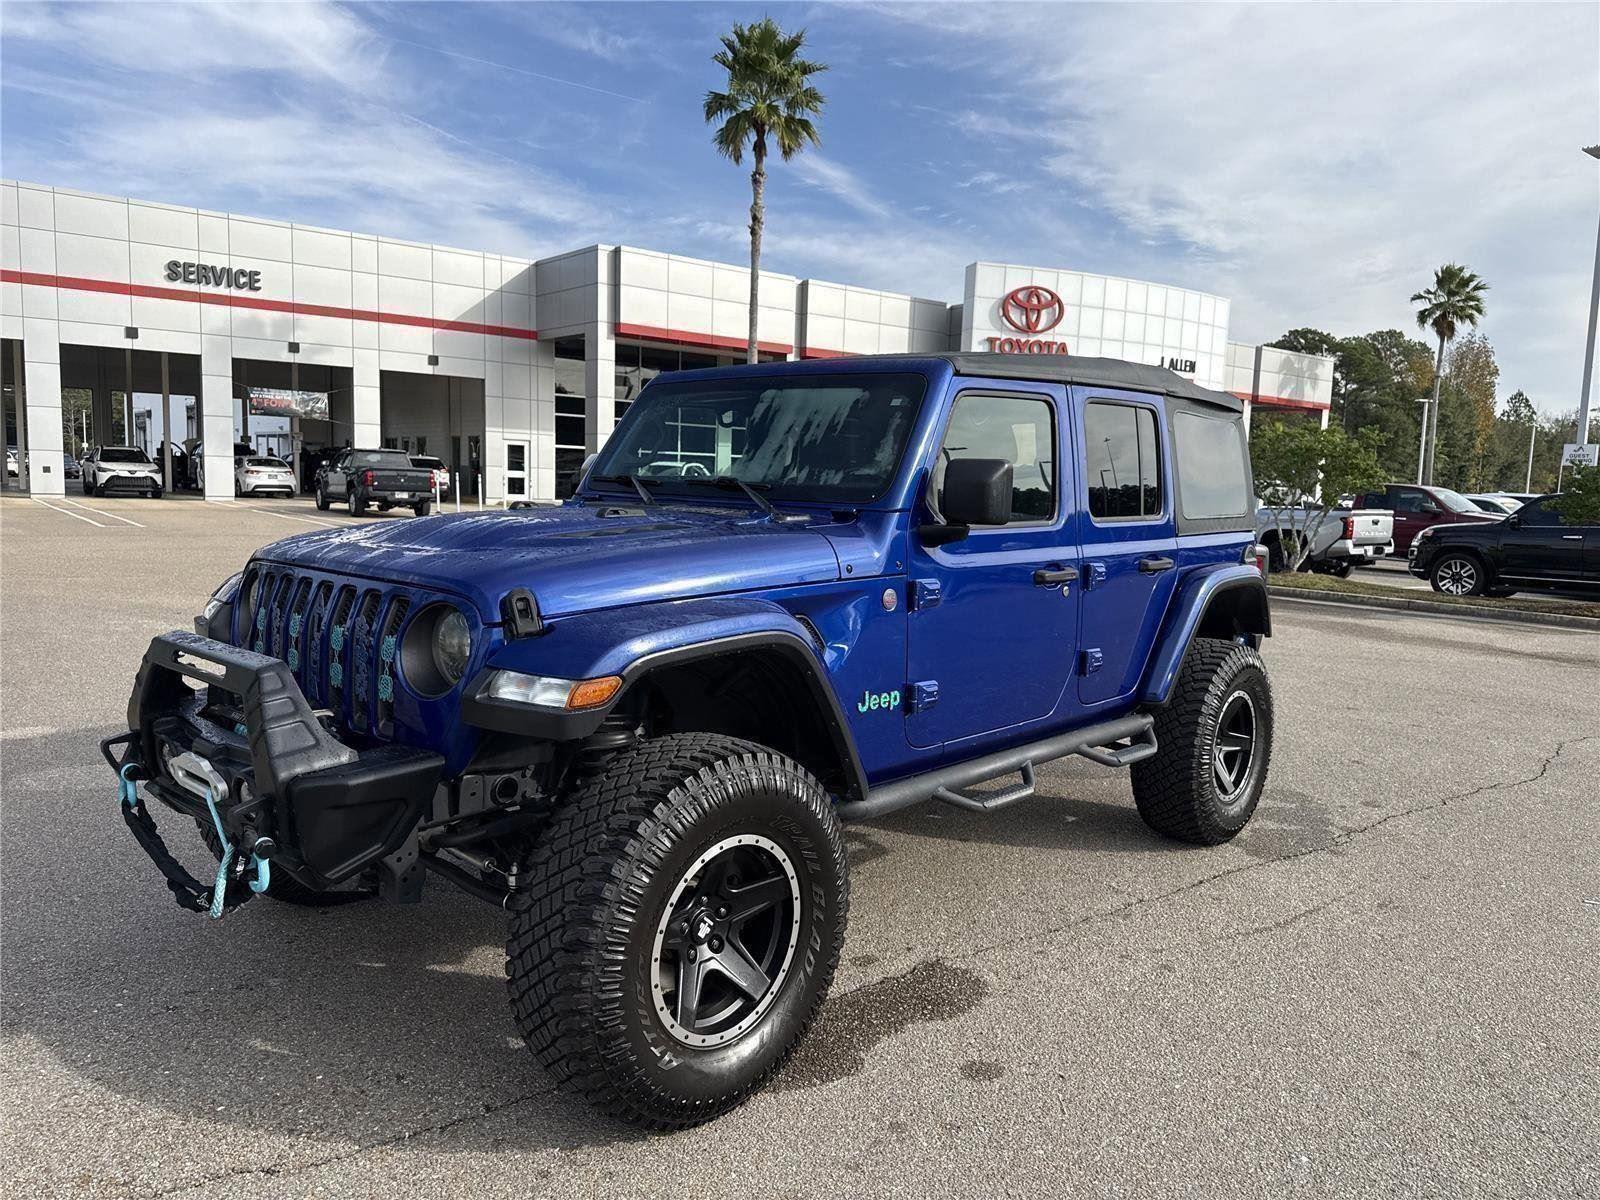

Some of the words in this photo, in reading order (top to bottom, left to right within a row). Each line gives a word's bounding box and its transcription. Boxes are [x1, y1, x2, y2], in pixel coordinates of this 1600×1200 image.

[166, 260, 262, 291] SERVICE
[986, 336, 1069, 356] TOYOTA
[1168, 357, 1196, 373] ALLEN
[857, 690, 900, 713] Jeep
[796, 881, 826, 1000] BLADE
